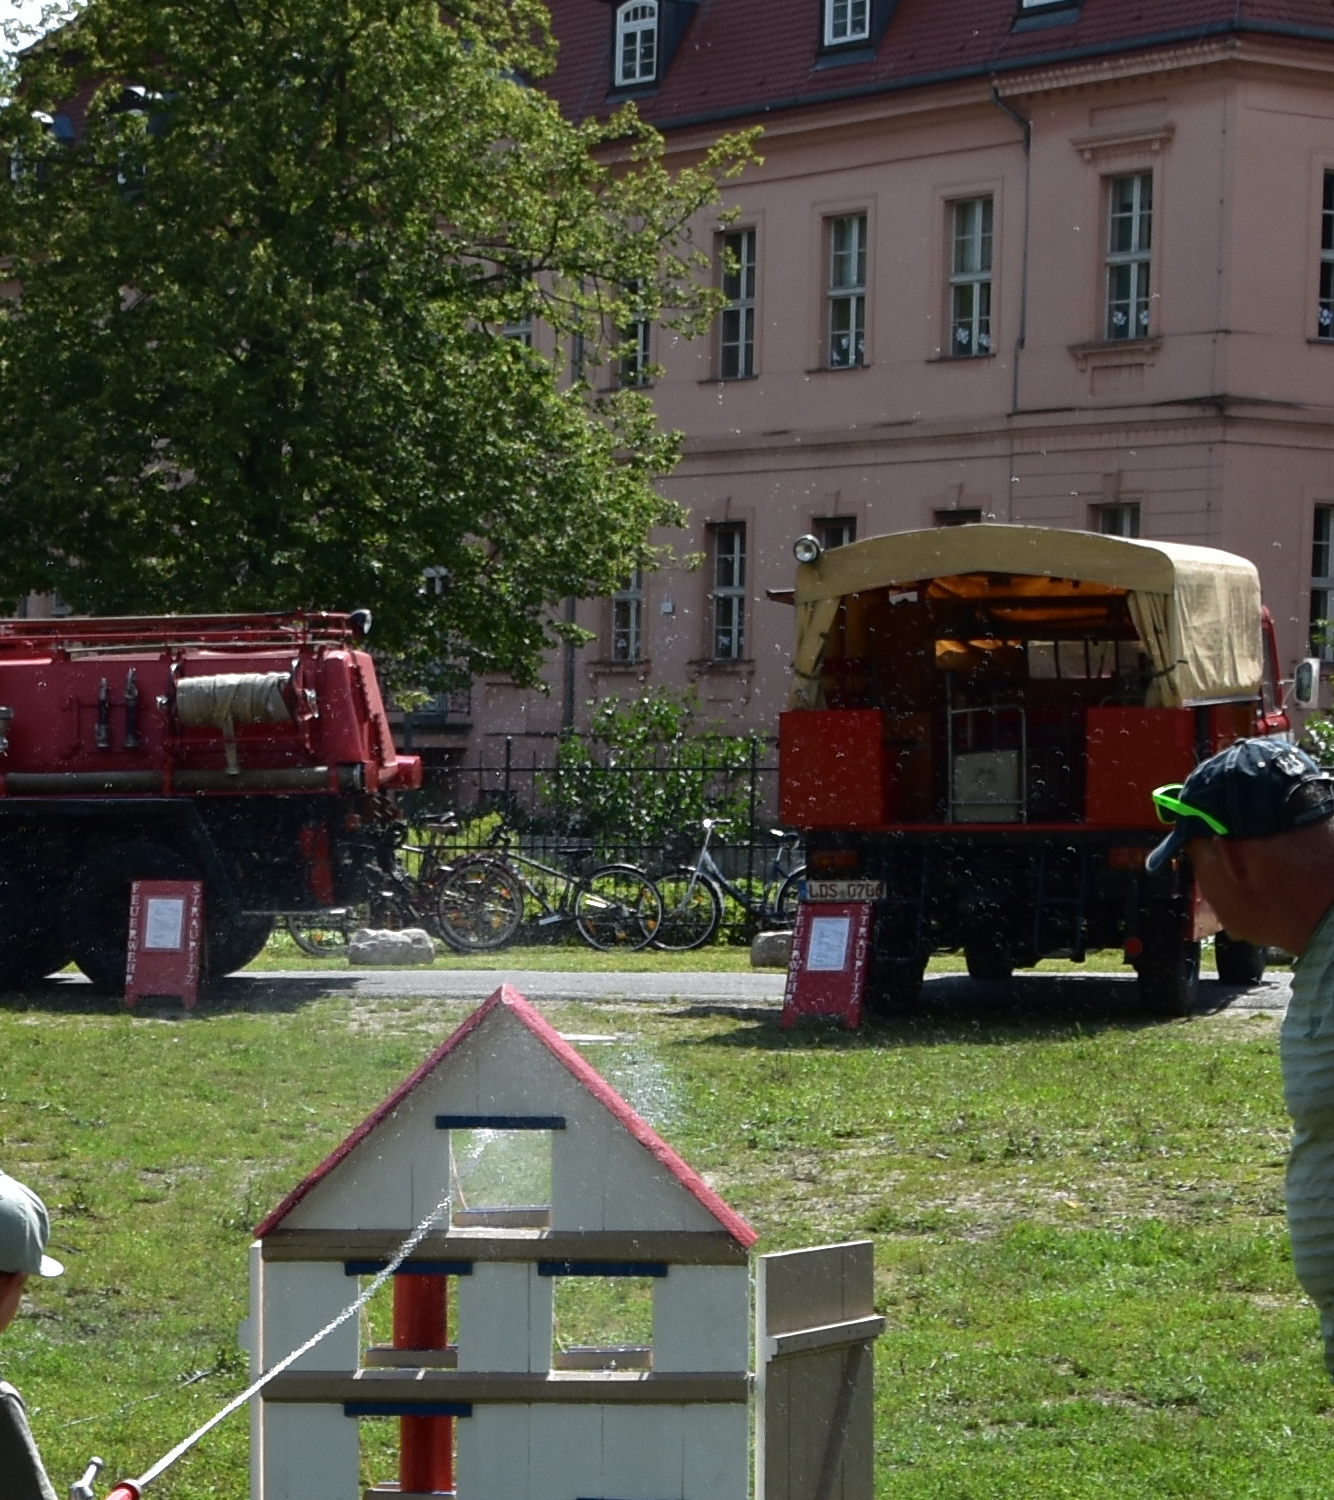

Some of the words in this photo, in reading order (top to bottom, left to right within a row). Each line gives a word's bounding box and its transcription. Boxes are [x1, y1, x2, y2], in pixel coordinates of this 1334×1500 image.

[125, 883, 140, 984] FEUERWEHR
[185, 883, 201, 985] STRAUPITZ
[809, 884, 838, 898] LDS
[785, 905, 805, 1004] FEUERWEHR
[850, 905, 870, 1004] STRAUPITZ
